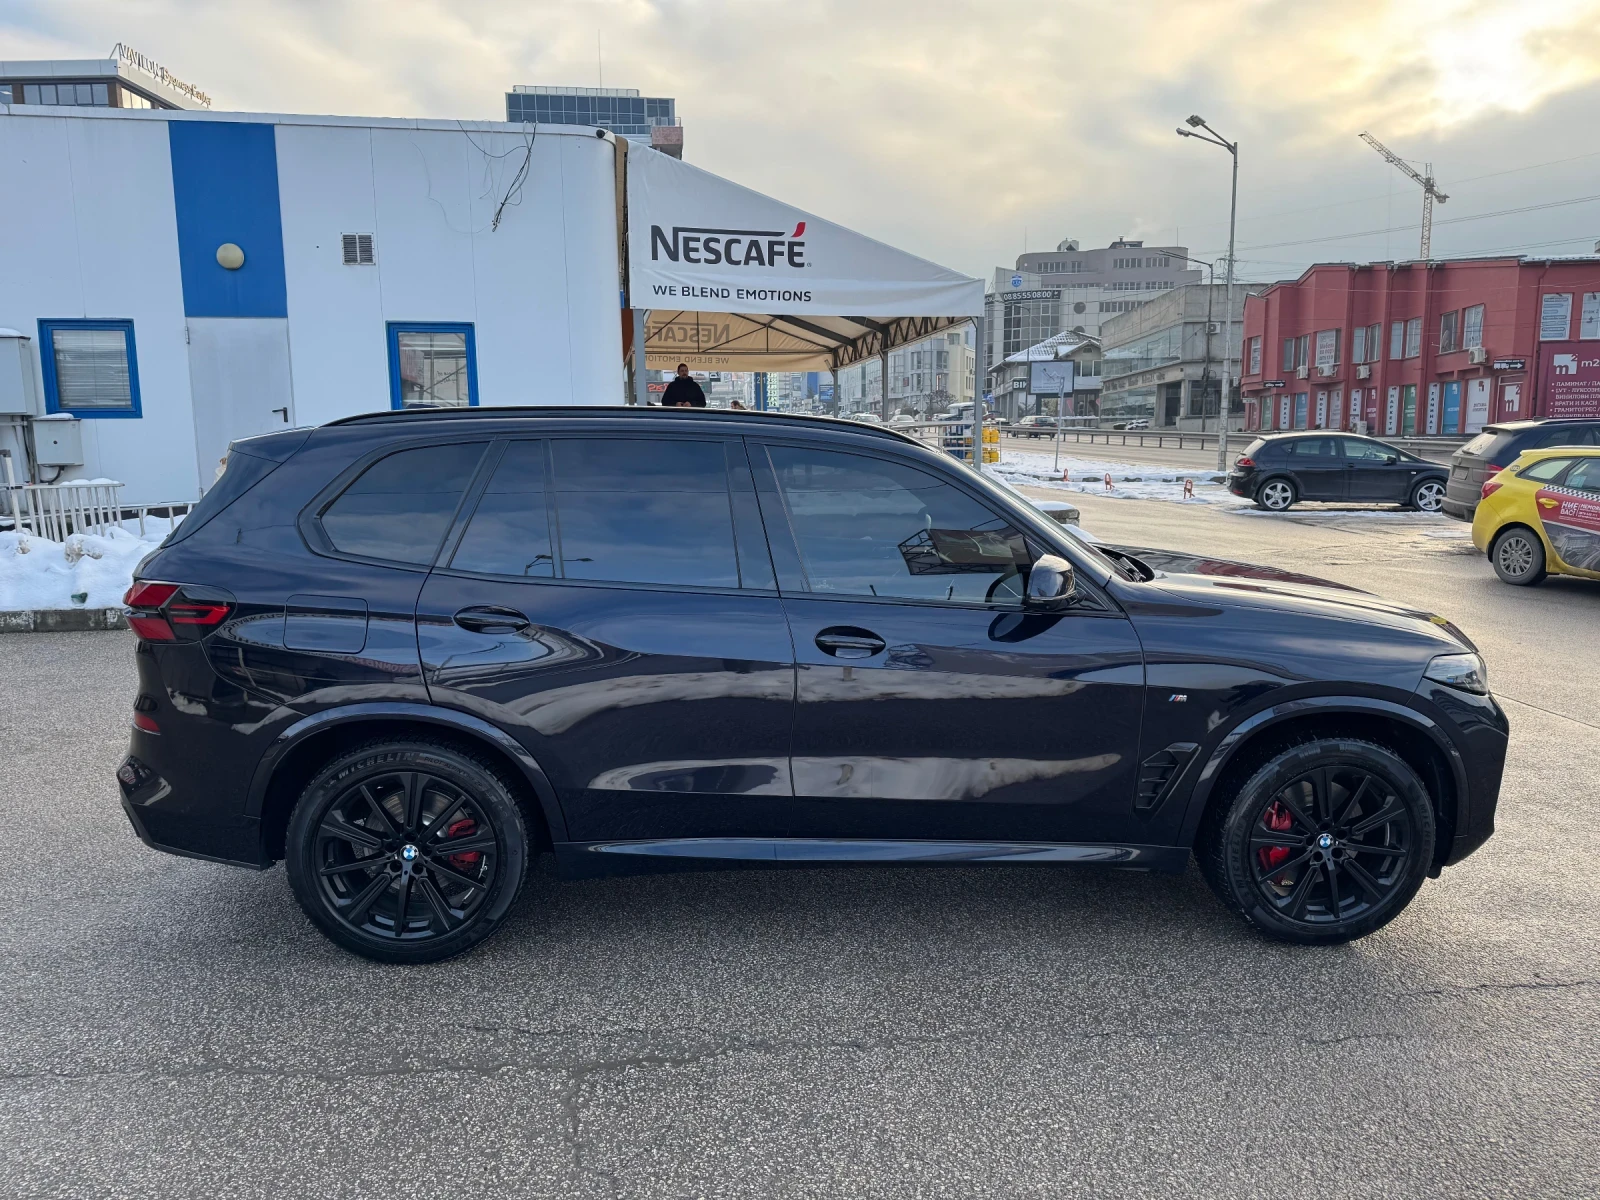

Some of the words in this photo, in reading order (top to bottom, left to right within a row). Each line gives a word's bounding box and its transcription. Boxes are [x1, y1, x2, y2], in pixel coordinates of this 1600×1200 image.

[651, 221, 806, 268] NESCAFÉ
[653, 285, 677, 297] WE
[682, 286, 730, 299] BLEND
[736, 288, 812, 302] EMOTIONS
[1561, 501, 1579, 509] НИЕ
[338, 752, 415, 780] MICHELIN
[1231, 821, 1245, 889] MICHELIN
